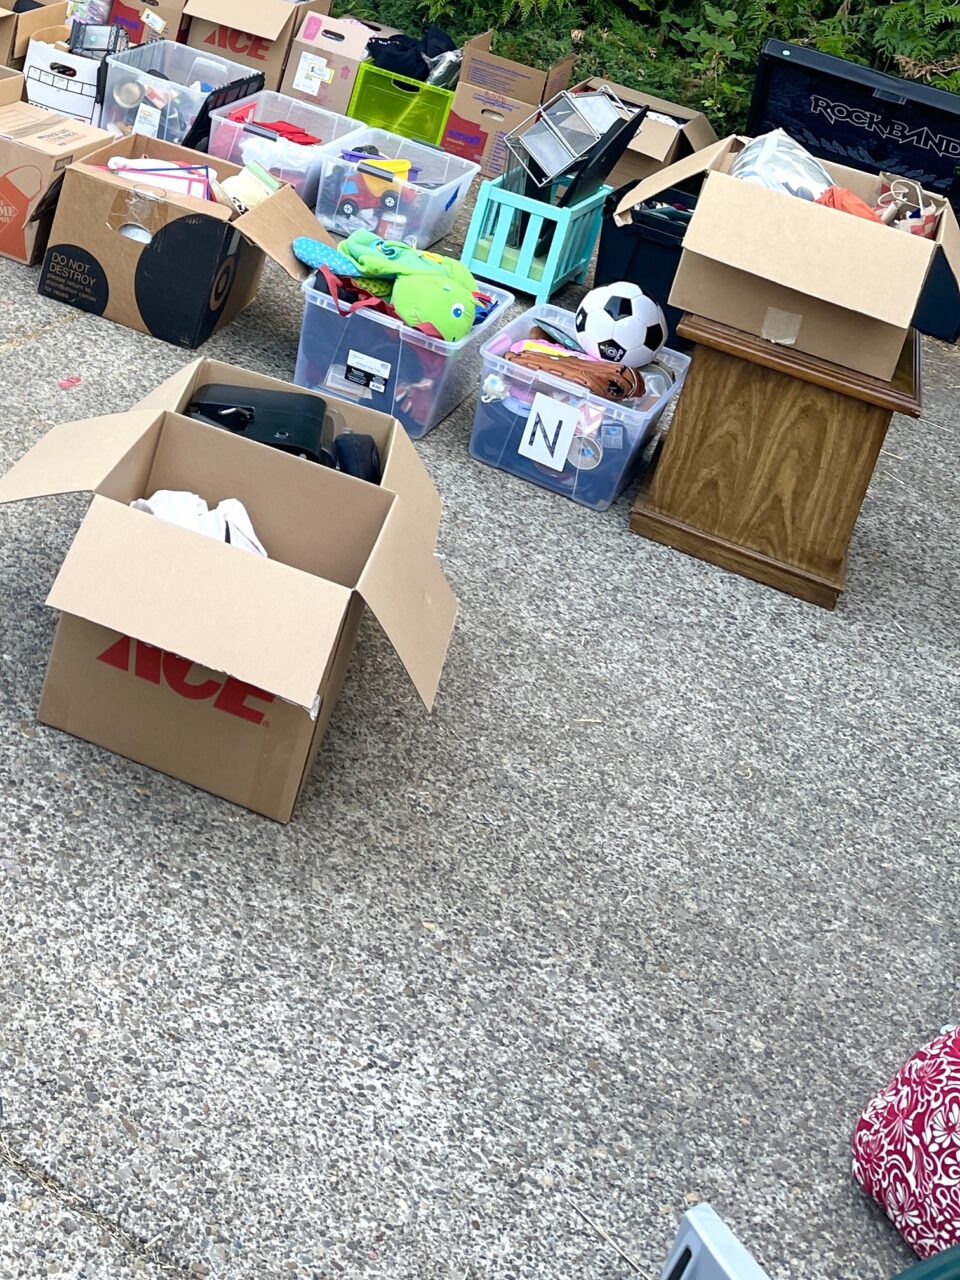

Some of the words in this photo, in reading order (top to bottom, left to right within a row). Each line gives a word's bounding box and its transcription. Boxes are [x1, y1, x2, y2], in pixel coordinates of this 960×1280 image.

[49, 262, 97, 287] DESTROY
[52, 252, 67, 266] DO
[68, 259, 91, 274] NOT
[528, 411, 564, 459] N
